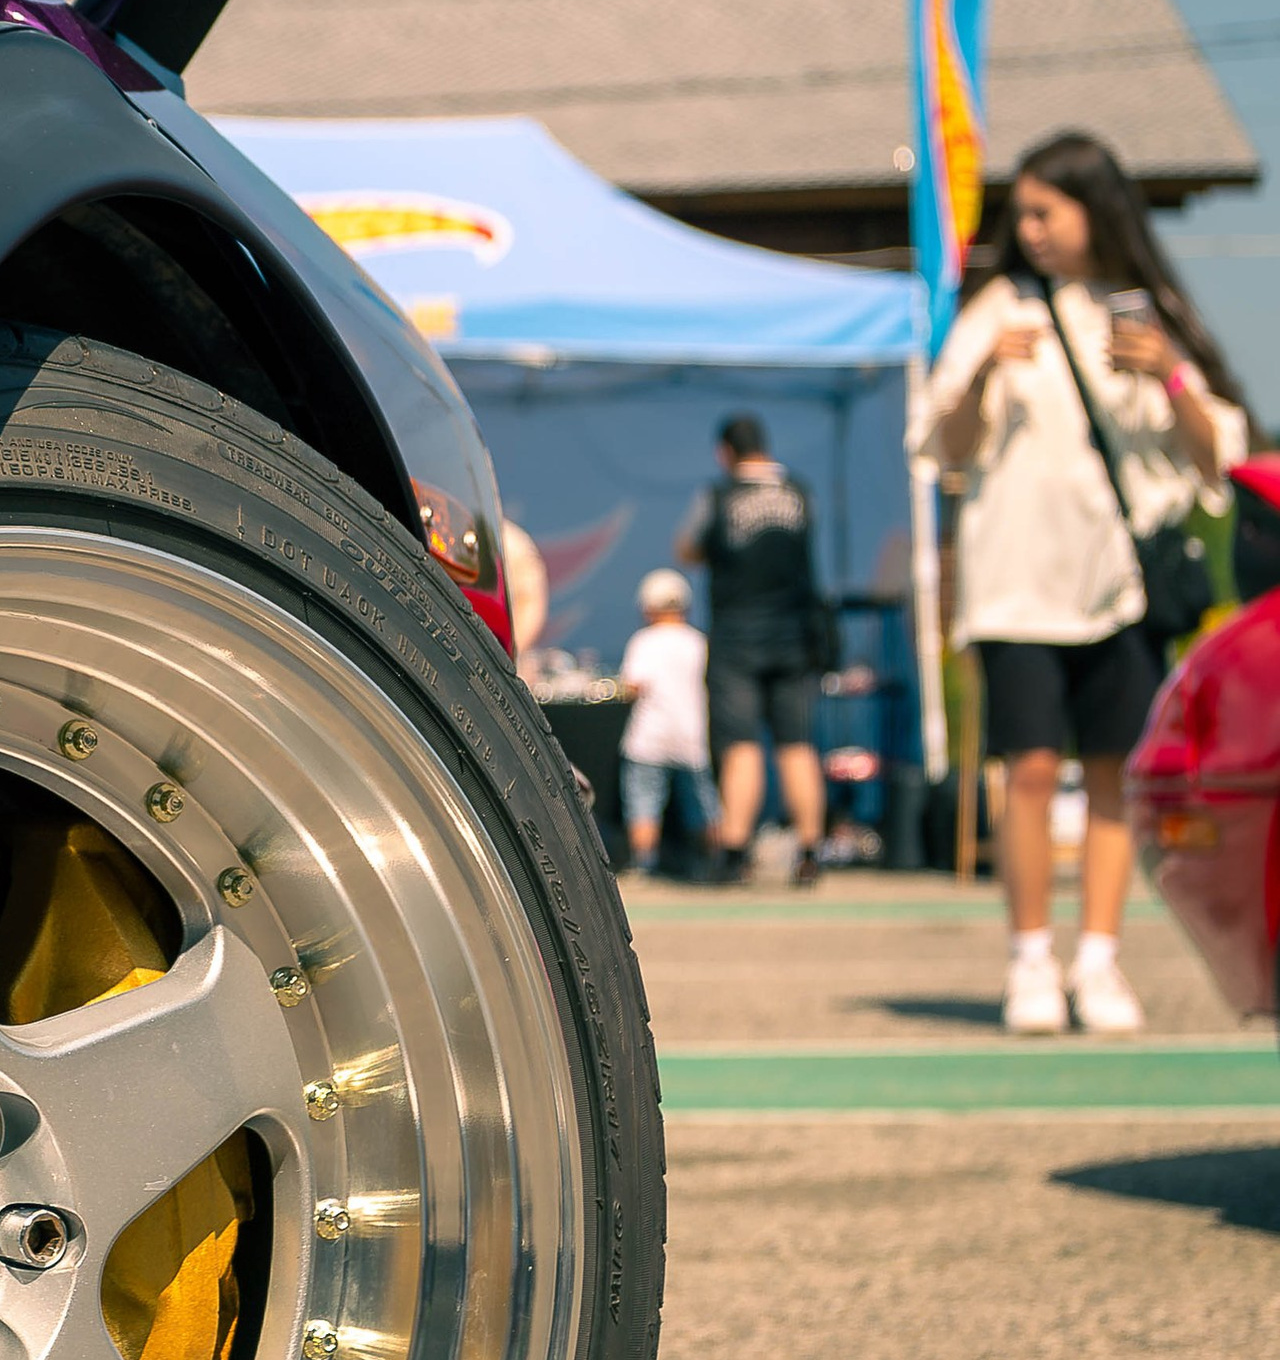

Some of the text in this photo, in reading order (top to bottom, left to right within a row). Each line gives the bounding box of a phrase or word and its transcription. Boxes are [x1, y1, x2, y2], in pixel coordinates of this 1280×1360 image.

[226, 446, 312, 505] TREADWEAR
[261, 525, 314, 572] DOT
[340, 538, 479, 678] OUTSIDE
